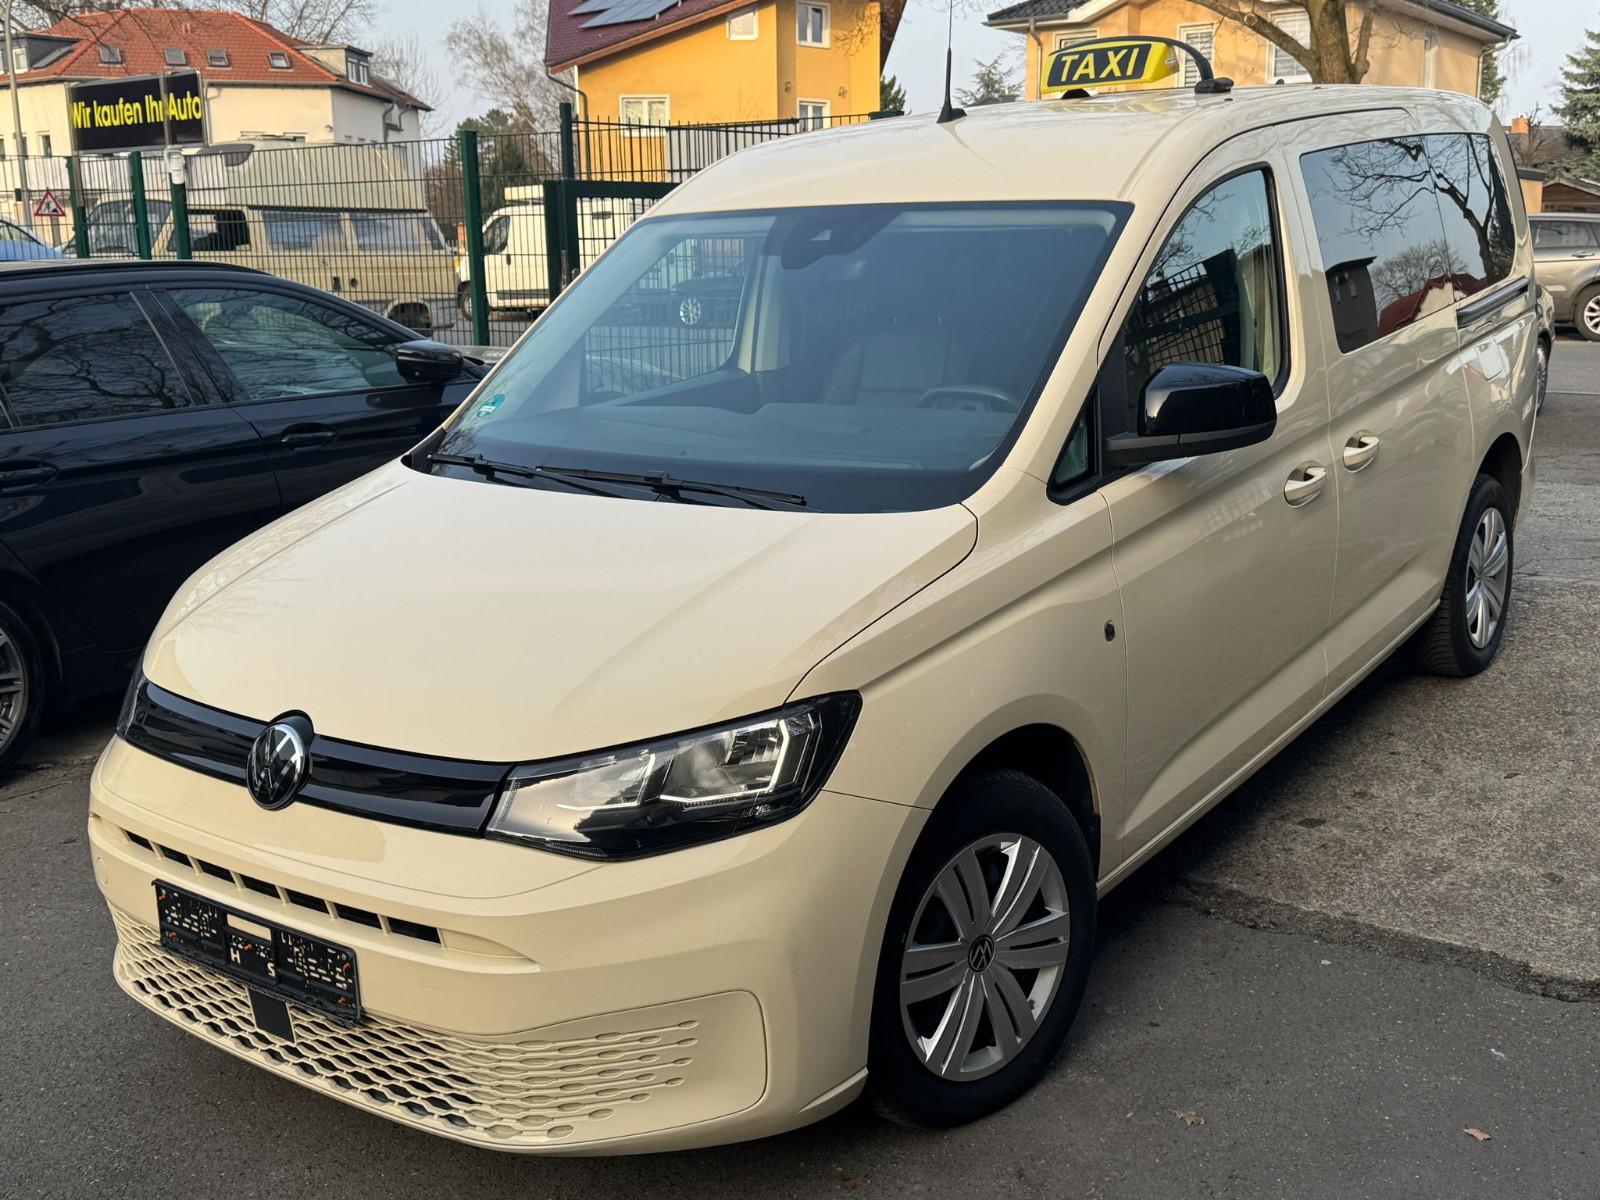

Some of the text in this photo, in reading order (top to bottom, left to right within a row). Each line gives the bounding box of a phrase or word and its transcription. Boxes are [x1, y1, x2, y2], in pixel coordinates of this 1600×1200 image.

[1060, 47, 1140, 82] TAXI
[93, 97, 144, 128] kaufen
[167, 90, 202, 120] Auto
